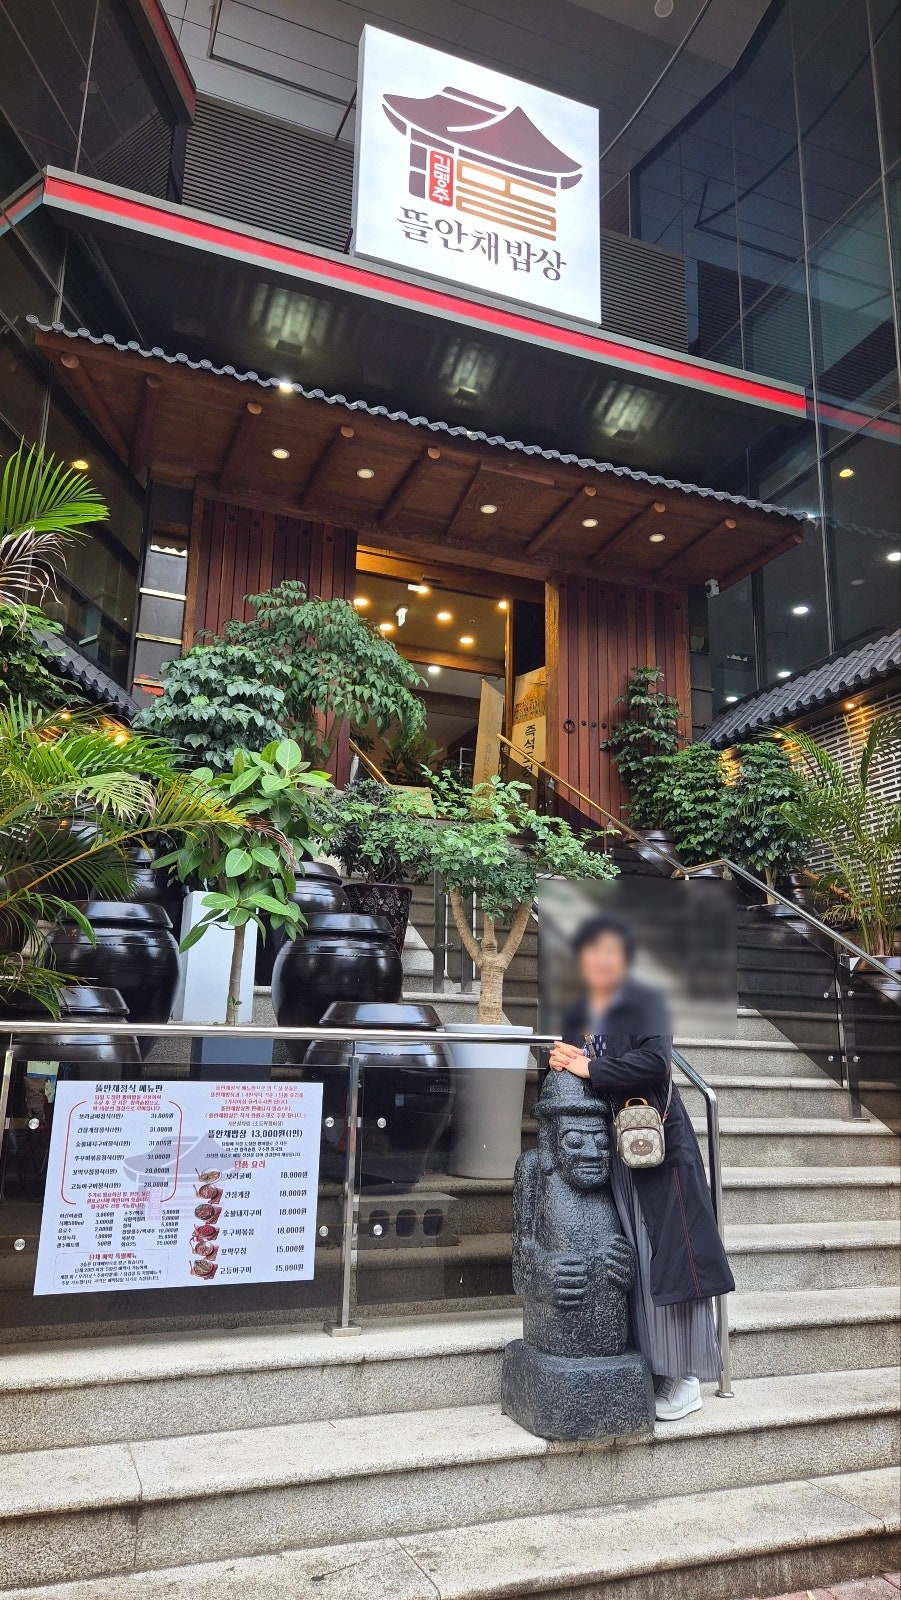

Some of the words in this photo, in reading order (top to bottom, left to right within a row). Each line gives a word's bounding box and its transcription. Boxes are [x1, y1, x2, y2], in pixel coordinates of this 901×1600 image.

[397, 206, 567, 281] 뜰안채밥상
[139, 1084, 163, 1092] 메뉴판
[208, 1130, 247, 1138] 뜰안채밥상
[251, 1130, 303, 1138] 13,000원(1인)
[251, 1160, 266, 1168] 요리
[280, 1171, 308, 1179] 18,000원
[277, 1226, 305, 1234] 18,000원
[221, 1247, 247, 1255] 꼬막무침
[276, 1245, 304, 1253] 15,000원
[220, 1266, 252, 1274] 고등어구이
[275, 1264, 304, 1272] 15,000원
